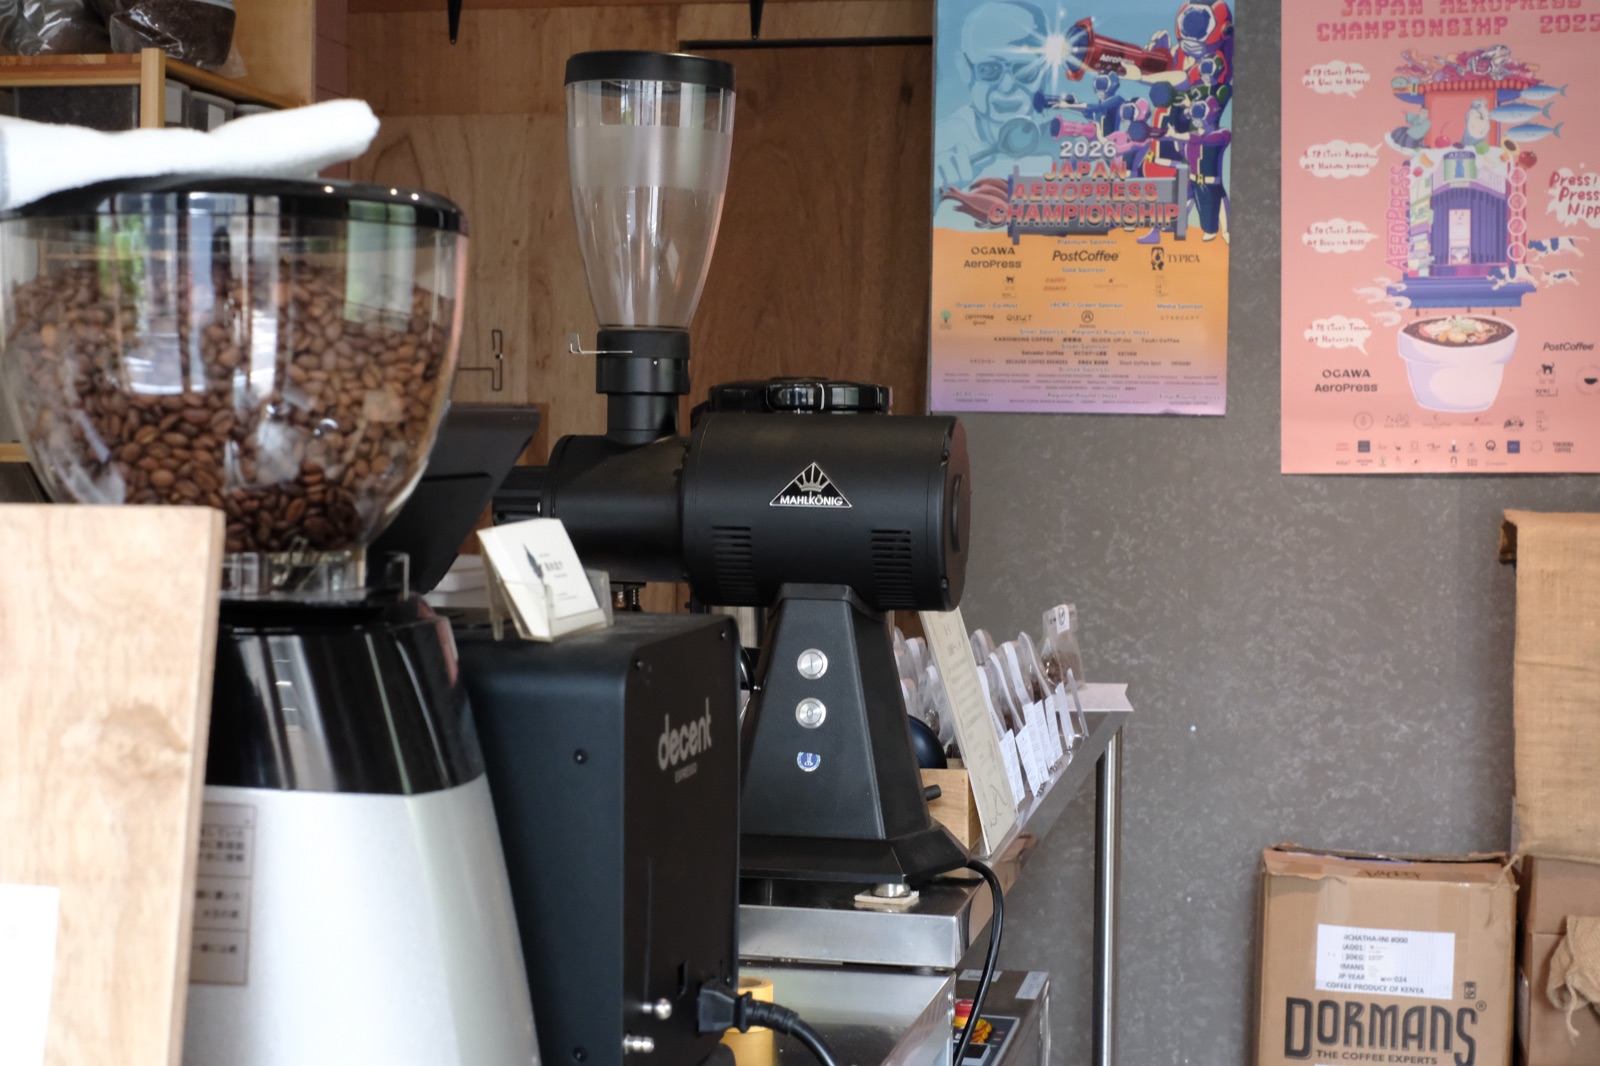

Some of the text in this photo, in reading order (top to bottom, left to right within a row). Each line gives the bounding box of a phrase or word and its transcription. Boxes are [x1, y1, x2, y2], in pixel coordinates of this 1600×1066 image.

[1341, 0, 1424, 17] JAPAN
[1540, 13, 1600, 34] 2025
[1059, 140, 1117, 158] 2026
[1043, 161, 1127, 182] JAPAN
[1548, 170, 1598, 189] Press!
[1010, 182, 1160, 204] AEROPRESS
[1558, 186, 1600, 203] Press
[988, 203, 1180, 227] CHAMPIONSHIP
[970, 246, 1016, 256] OGAWA
[1052, 249, 1119, 262] PostCoffee
[1167, 253, 1201, 264] TYPICA
[963, 259, 1022, 269] AeroPress
[1543, 342, 1595, 351] PostCoffee
[1322, 368, 1372, 379] OGAWA
[1314, 383, 1378, 393] AeroPress
[780, 491, 844, 506] MAHLKÖNIG
[658, 696, 712, 771] decent
[1325, 981, 1353, 991] COFFEE
[1353, 983, 1387, 993] PRODUCE
[1400, 986, 1425, 995] KENYA
[1284, 996, 1478, 1066] DORMANS
[1316, 1050, 1439, 1066] THE COFFEE EXPERTS
